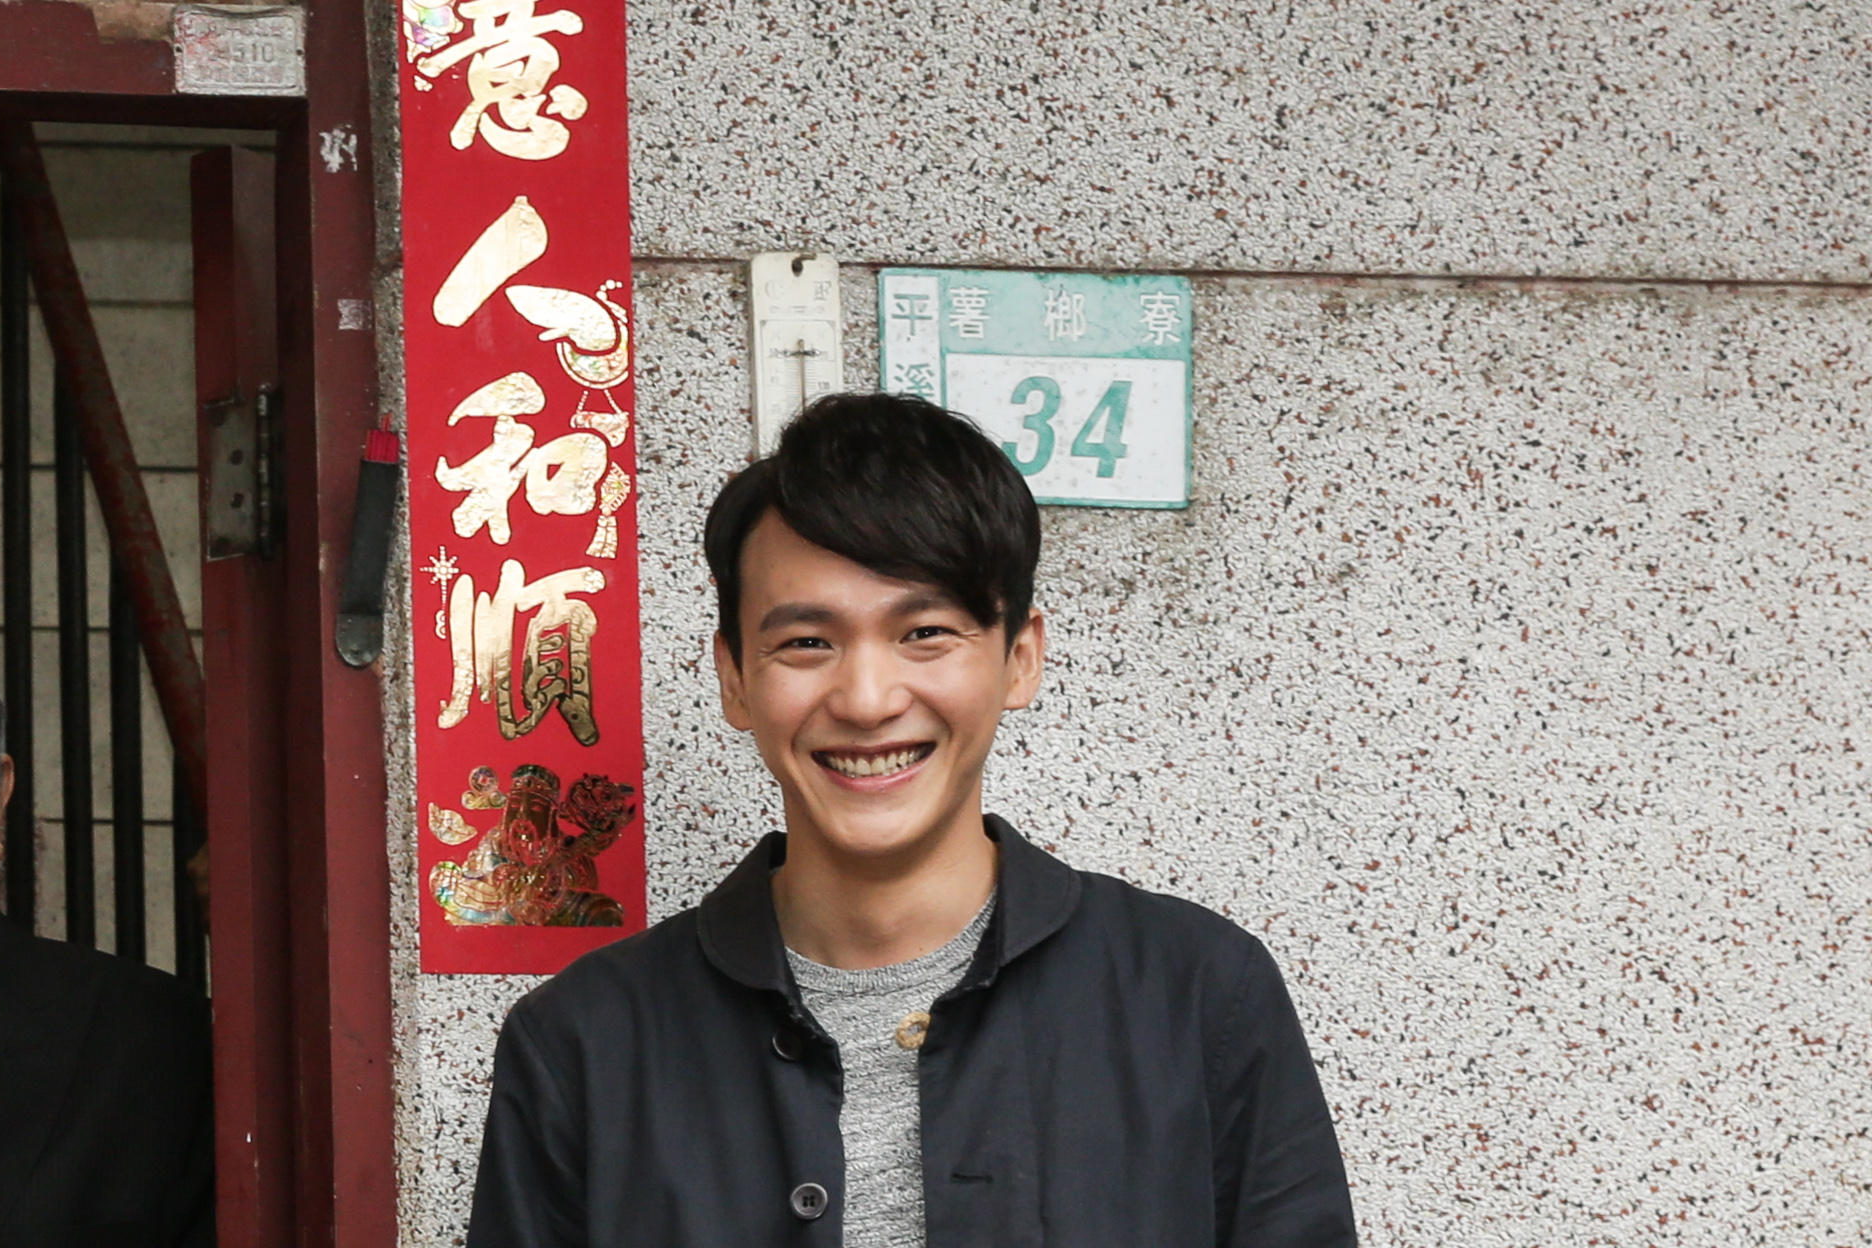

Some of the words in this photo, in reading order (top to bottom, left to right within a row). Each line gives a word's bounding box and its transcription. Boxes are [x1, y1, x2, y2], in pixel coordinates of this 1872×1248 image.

[948, 286, 1182, 346] 薯榔寮
[417, 0, 617, 746] 意人和順
[1002, 376, 1133, 478] 34
